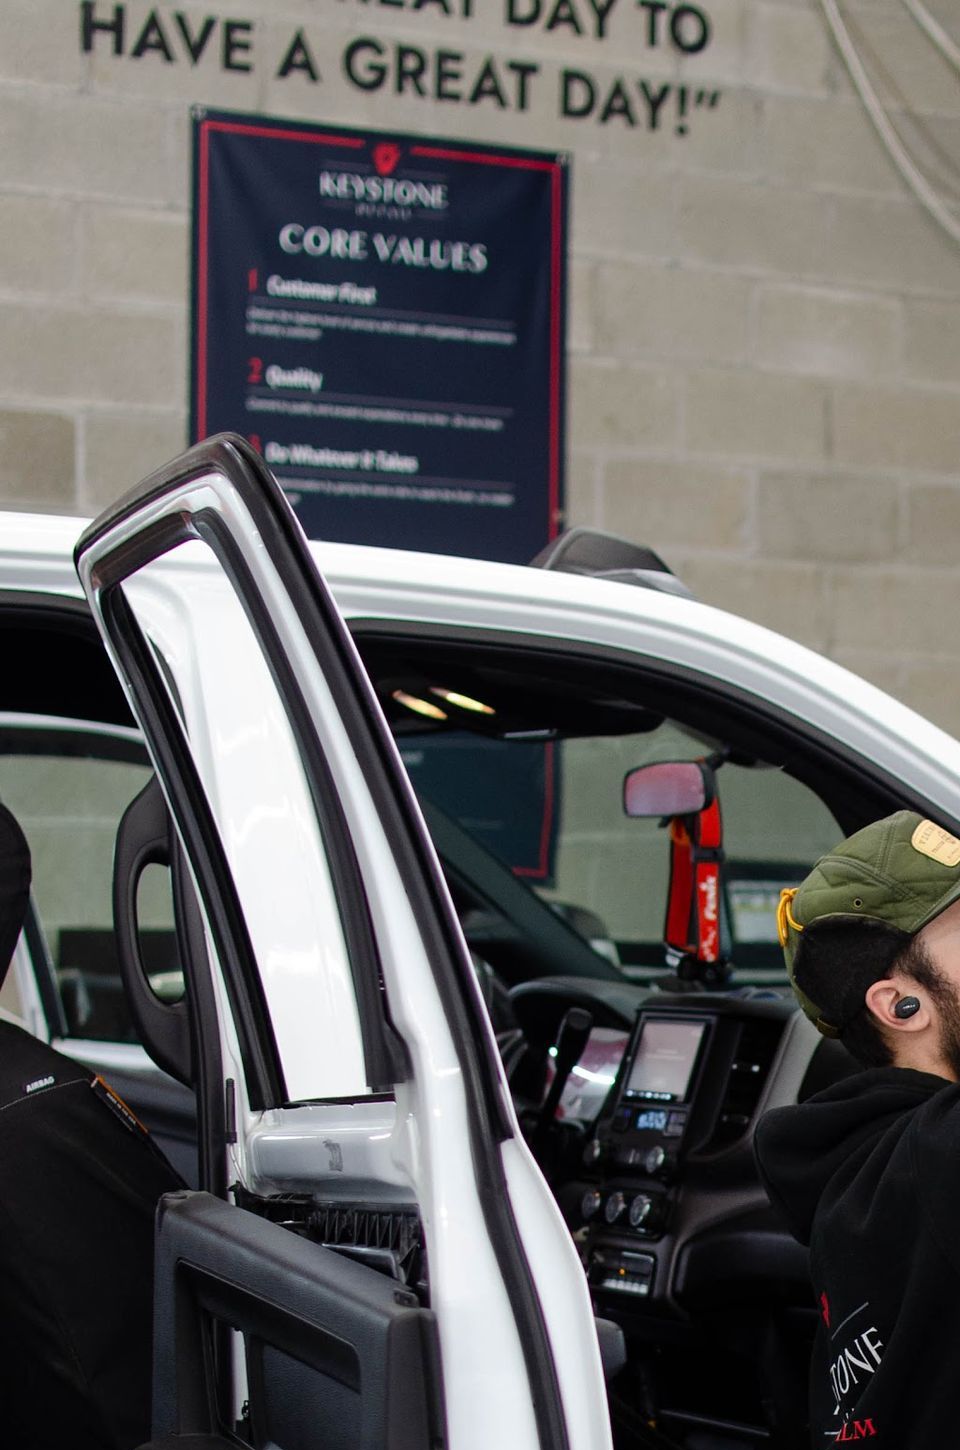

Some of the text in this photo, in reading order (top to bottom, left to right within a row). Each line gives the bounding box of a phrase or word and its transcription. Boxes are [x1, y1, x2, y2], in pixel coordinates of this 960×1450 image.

[638, 0, 712, 54] TO
[80, 0, 254, 73] HAVE
[276, 27, 319, 83] A
[344, 36, 538, 111] GREAT
[319, 171, 448, 209] KEYSTONE
[279, 223, 488, 273] CORE VALUES
[248, 357, 323, 393] 2 Quality
[26, 1076, 55, 1093] AIRBAG
